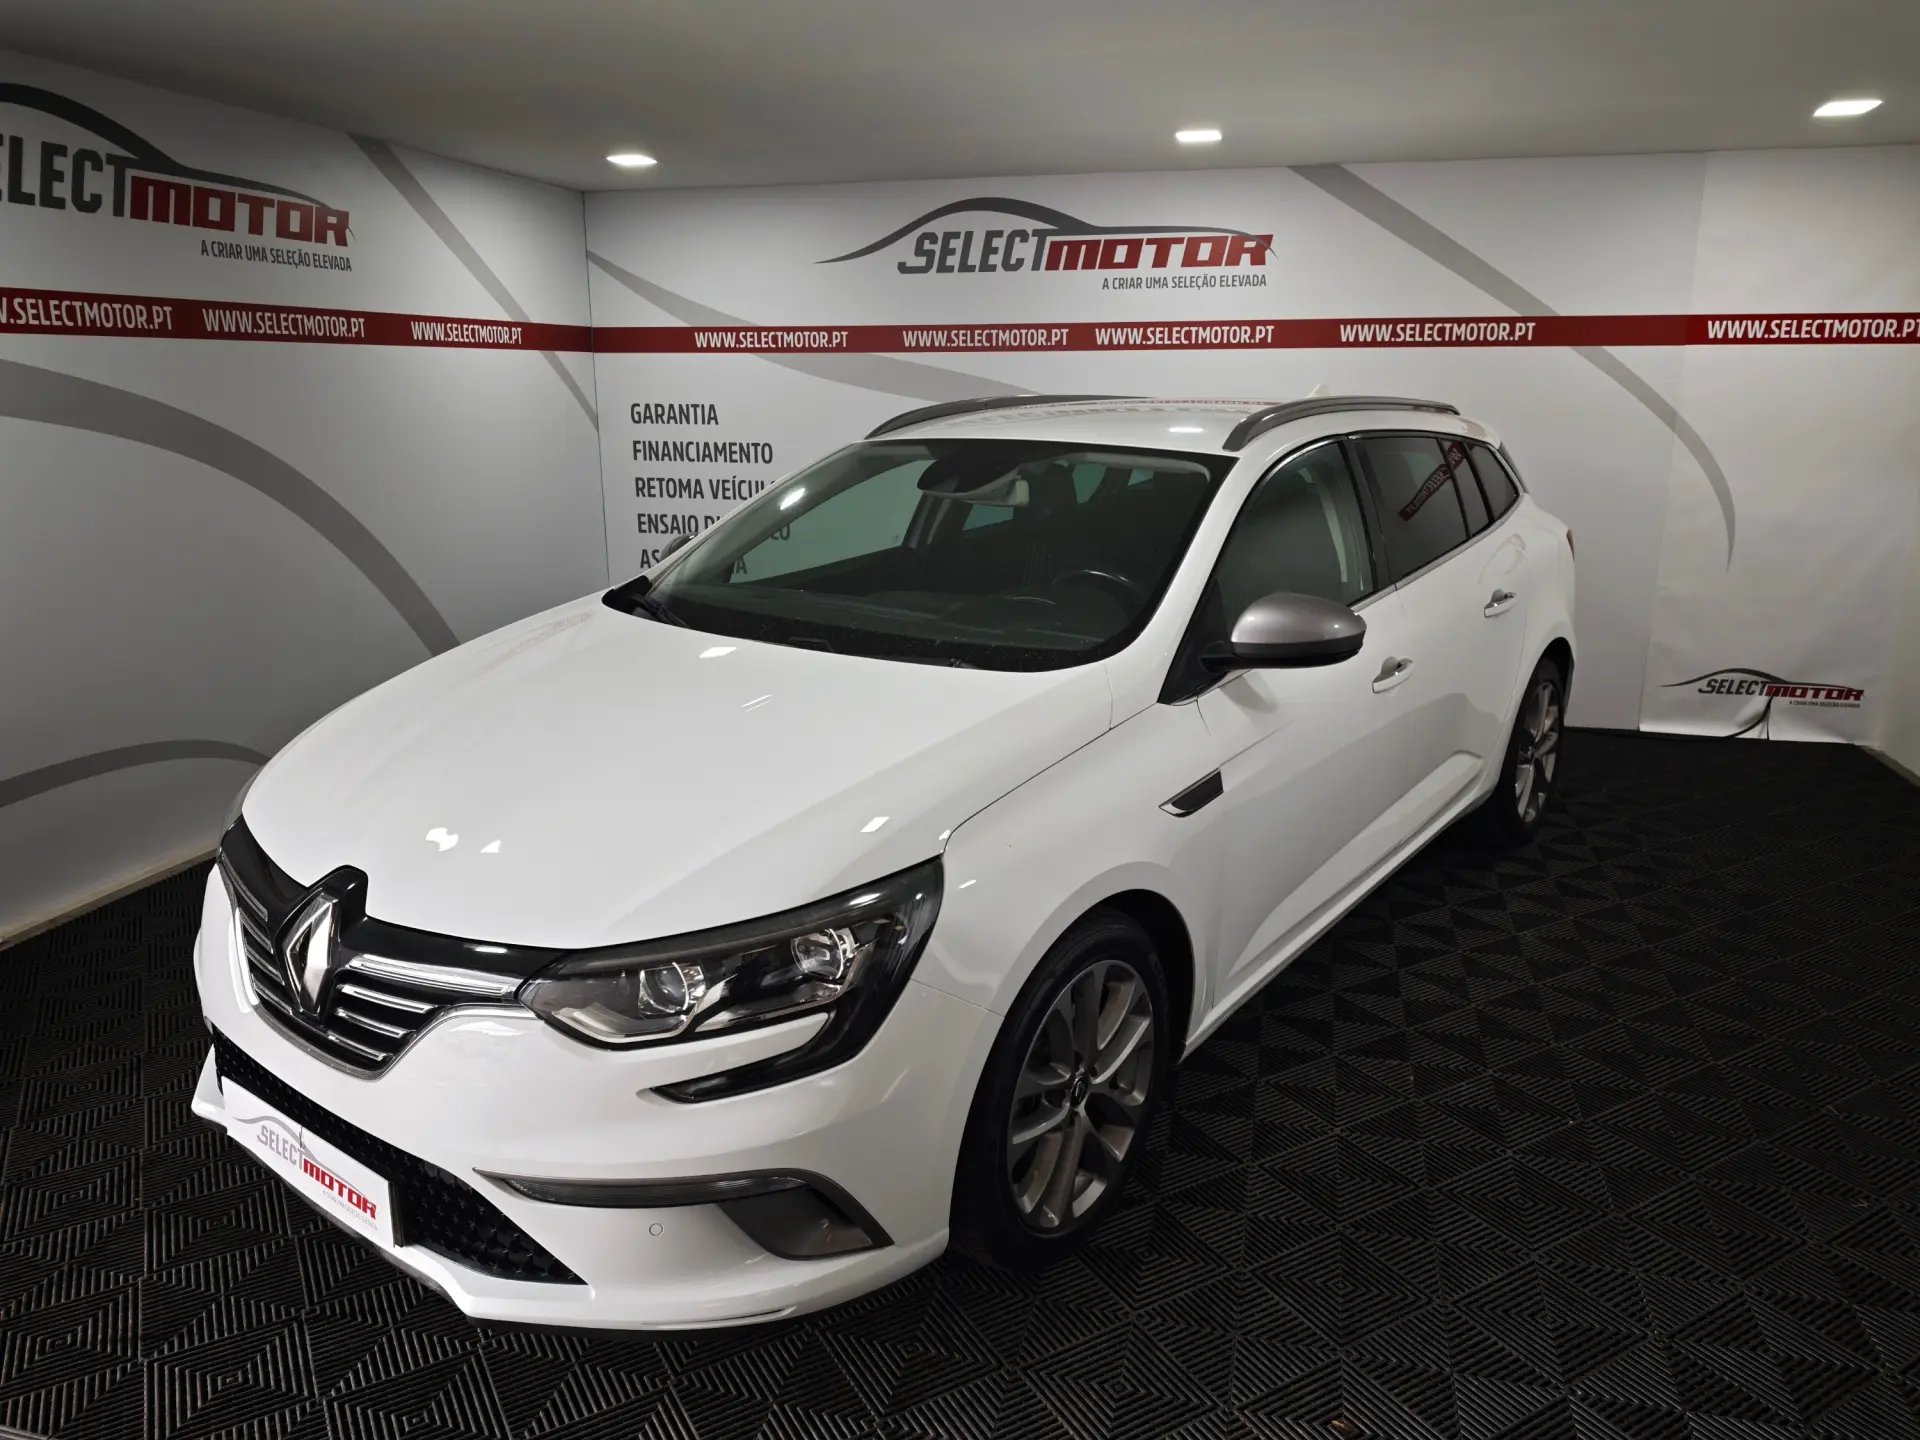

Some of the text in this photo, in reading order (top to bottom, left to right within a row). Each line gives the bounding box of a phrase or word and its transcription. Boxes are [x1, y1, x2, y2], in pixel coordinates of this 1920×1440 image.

[0, 132, 350, 247] LECTMOTOR
[201, 239, 352, 271] A CRIAR UMA SELEÇÃO ELEVADA
[1102, 273, 1267, 290] A CRIAR UMA SELEÇÃO ELEVADA
[202, 308, 365, 338] WWW.SELECTMOTOR.PT
[410, 320, 522, 345] WWW.SELECTMOTOR.PT
[695, 331, 849, 348] WWW.SELECTMOTOR.PT
[903, 328, 1069, 347] WWW.SELECTMOTOR.PT
[1095, 325, 1275, 346] WWW.SELECTMOTOR.PT
[1339, 322, 1536, 342] WWW.SELECTMOTOR.PT
[630, 403, 719, 425] GARANTIA
[632, 440, 773, 464] FINANCIAMENTO
[635, 477, 704, 499] RETOMA
[637, 514, 699, 534] ENSAIO
